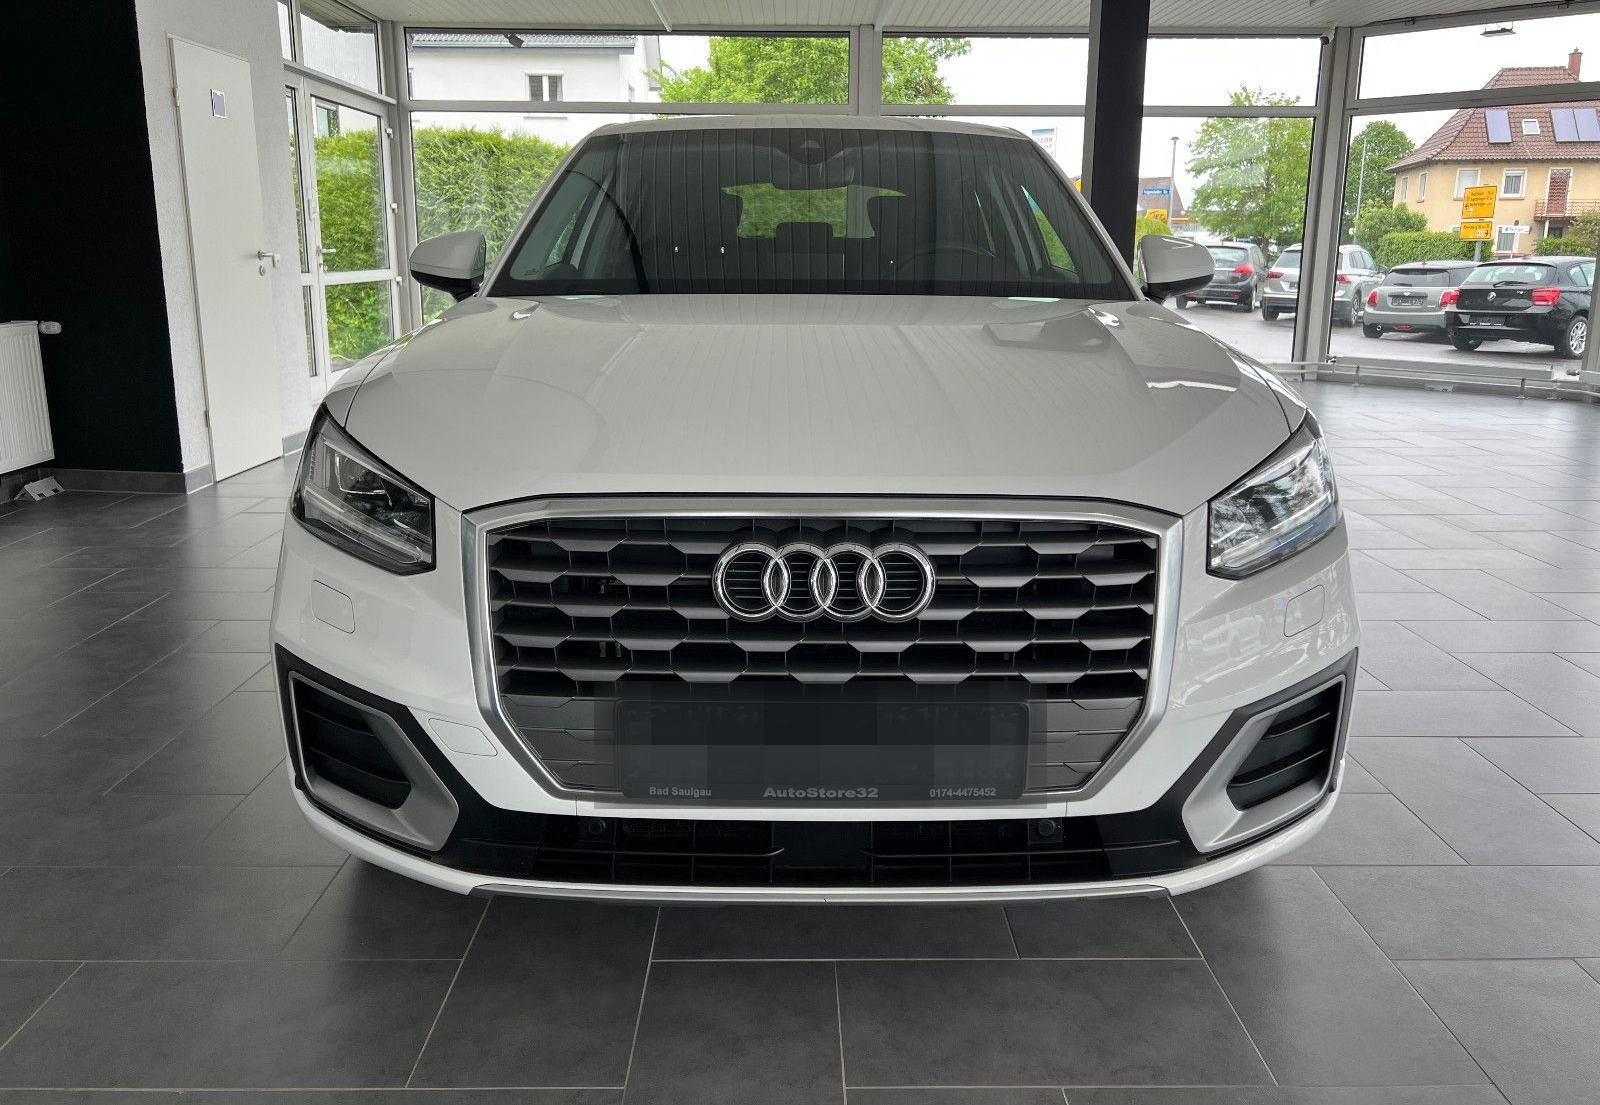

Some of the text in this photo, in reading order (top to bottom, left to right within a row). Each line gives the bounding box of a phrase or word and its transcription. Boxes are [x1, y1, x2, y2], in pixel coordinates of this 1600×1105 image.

[649, 786, 712, 798] Bad Saulgau
[763, 786, 879, 798] AutoStore32
[929, 787, 997, 797] 0174-4475452
